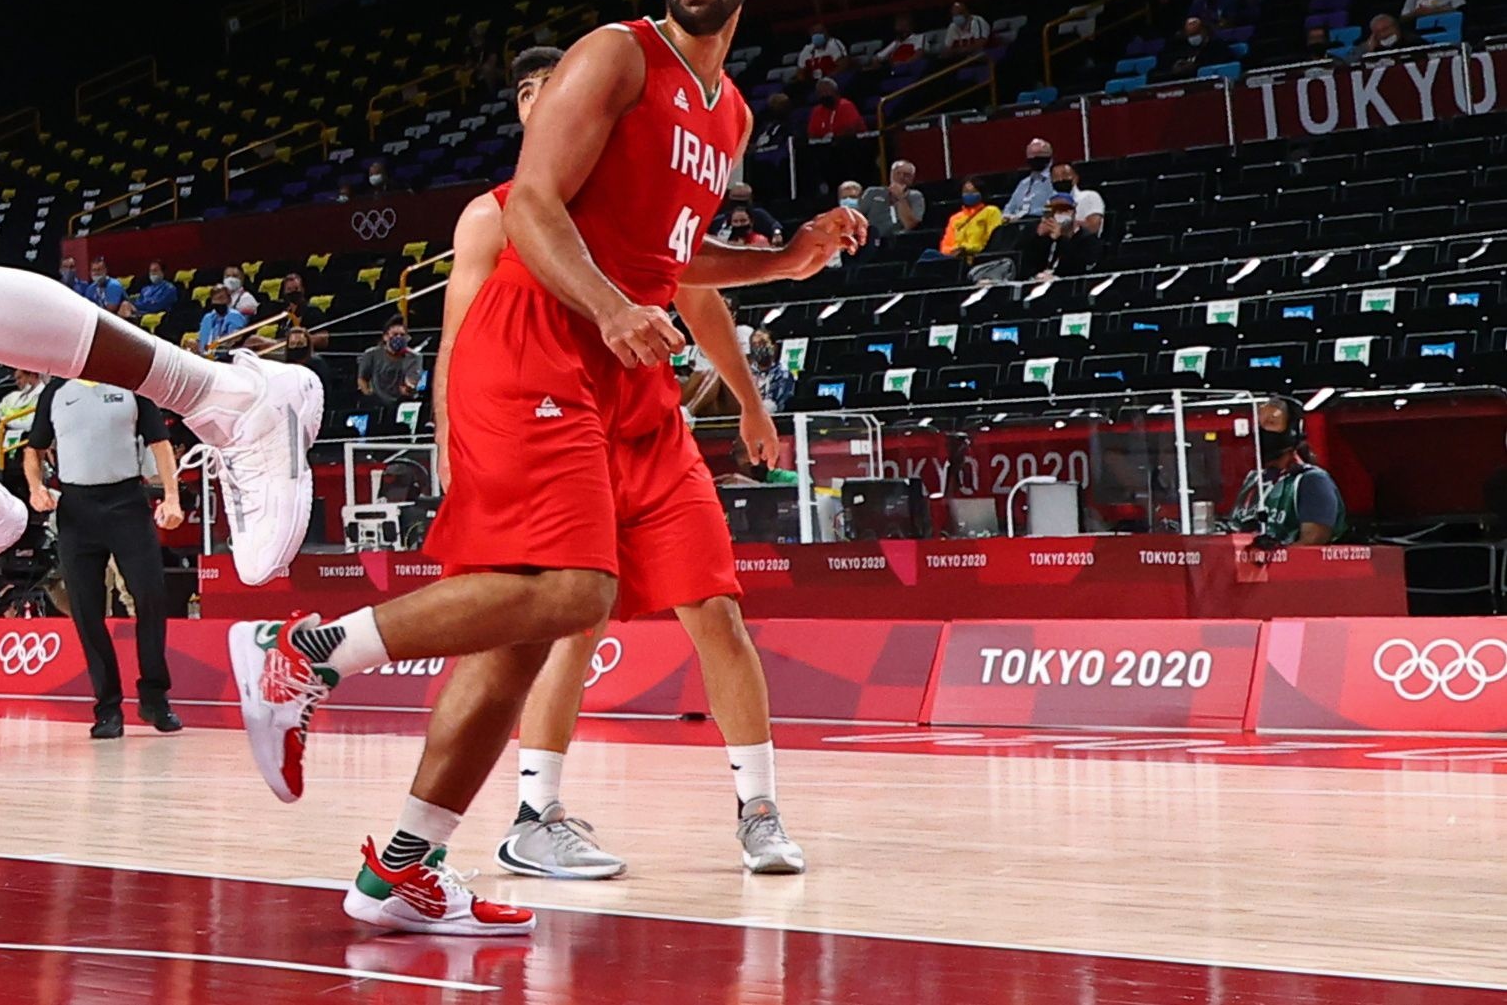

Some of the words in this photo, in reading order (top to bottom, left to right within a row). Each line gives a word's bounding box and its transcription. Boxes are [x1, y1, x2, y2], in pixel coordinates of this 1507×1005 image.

[1246, 52, 1499, 141] TOKYO
[670, 124, 733, 200] IRAN
[926, 555, 959, 568] TOKYO
[960, 553, 987, 567] 2020
[1029, 553, 1065, 566] TOKYO
[1066, 552, 1094, 566] 2020
[1139, 550, 1176, 565] TOKYO
[1321, 548, 1350, 561] TOKYO
[1350, 546, 1372, 560] 2020
[395, 564, 421, 576] TOKYO
[422, 564, 442, 576] 2020
[734, 560, 765, 572] TOKYO
[767, 558, 790, 571] 2020
[828, 557, 860, 570] TOKYO
[861, 556, 886, 569] 2020
[319, 566, 344, 577] TOKYO
[345, 565, 364, 577] 2020
[979, 648, 1105, 686] TOKYO
[1110, 649, 1212, 689] 2020
